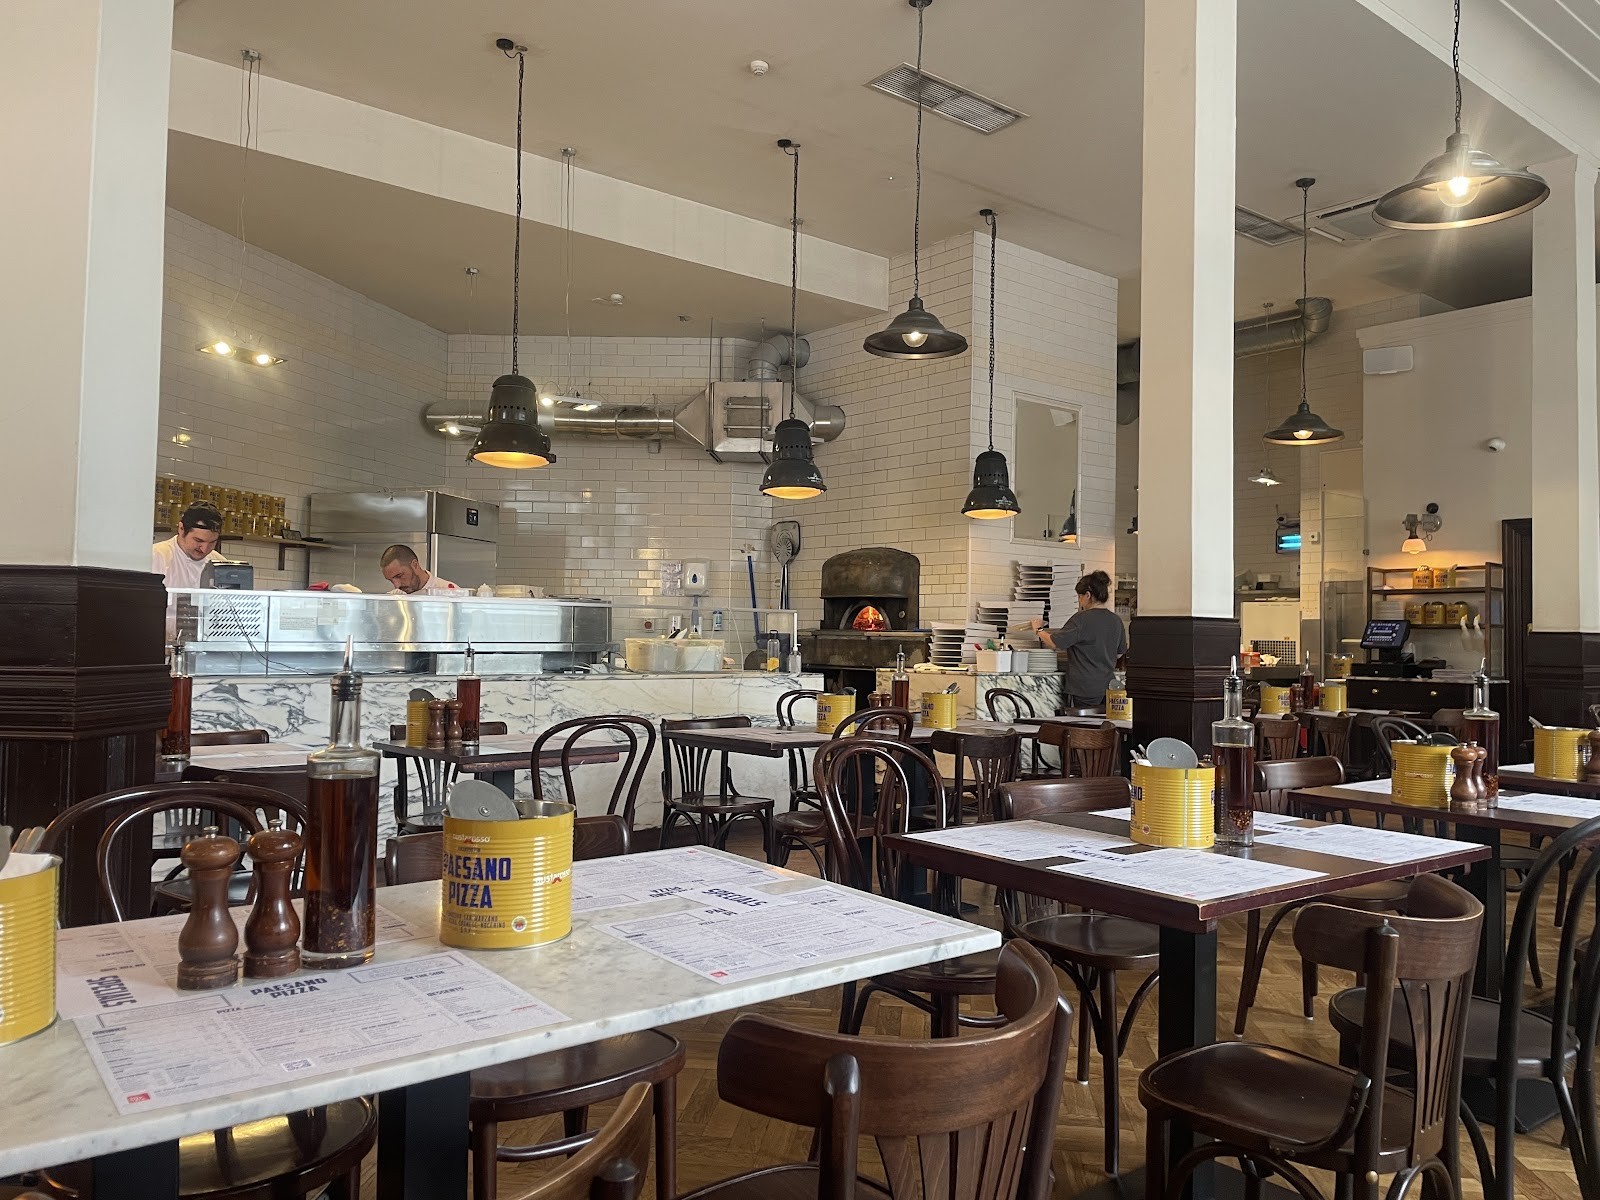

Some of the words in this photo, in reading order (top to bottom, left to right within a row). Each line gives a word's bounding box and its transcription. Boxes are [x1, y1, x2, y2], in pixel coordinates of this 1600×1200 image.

[449, 883, 492, 908] PIZZA
[702, 888, 768, 907] SPECIALS
[86, 975, 137, 1008] SPECIALS
[250, 977, 328, 996] PAESANO
[270, 985, 320, 999] PIZZA
[216, 1007, 243, 1015] PIZZA
